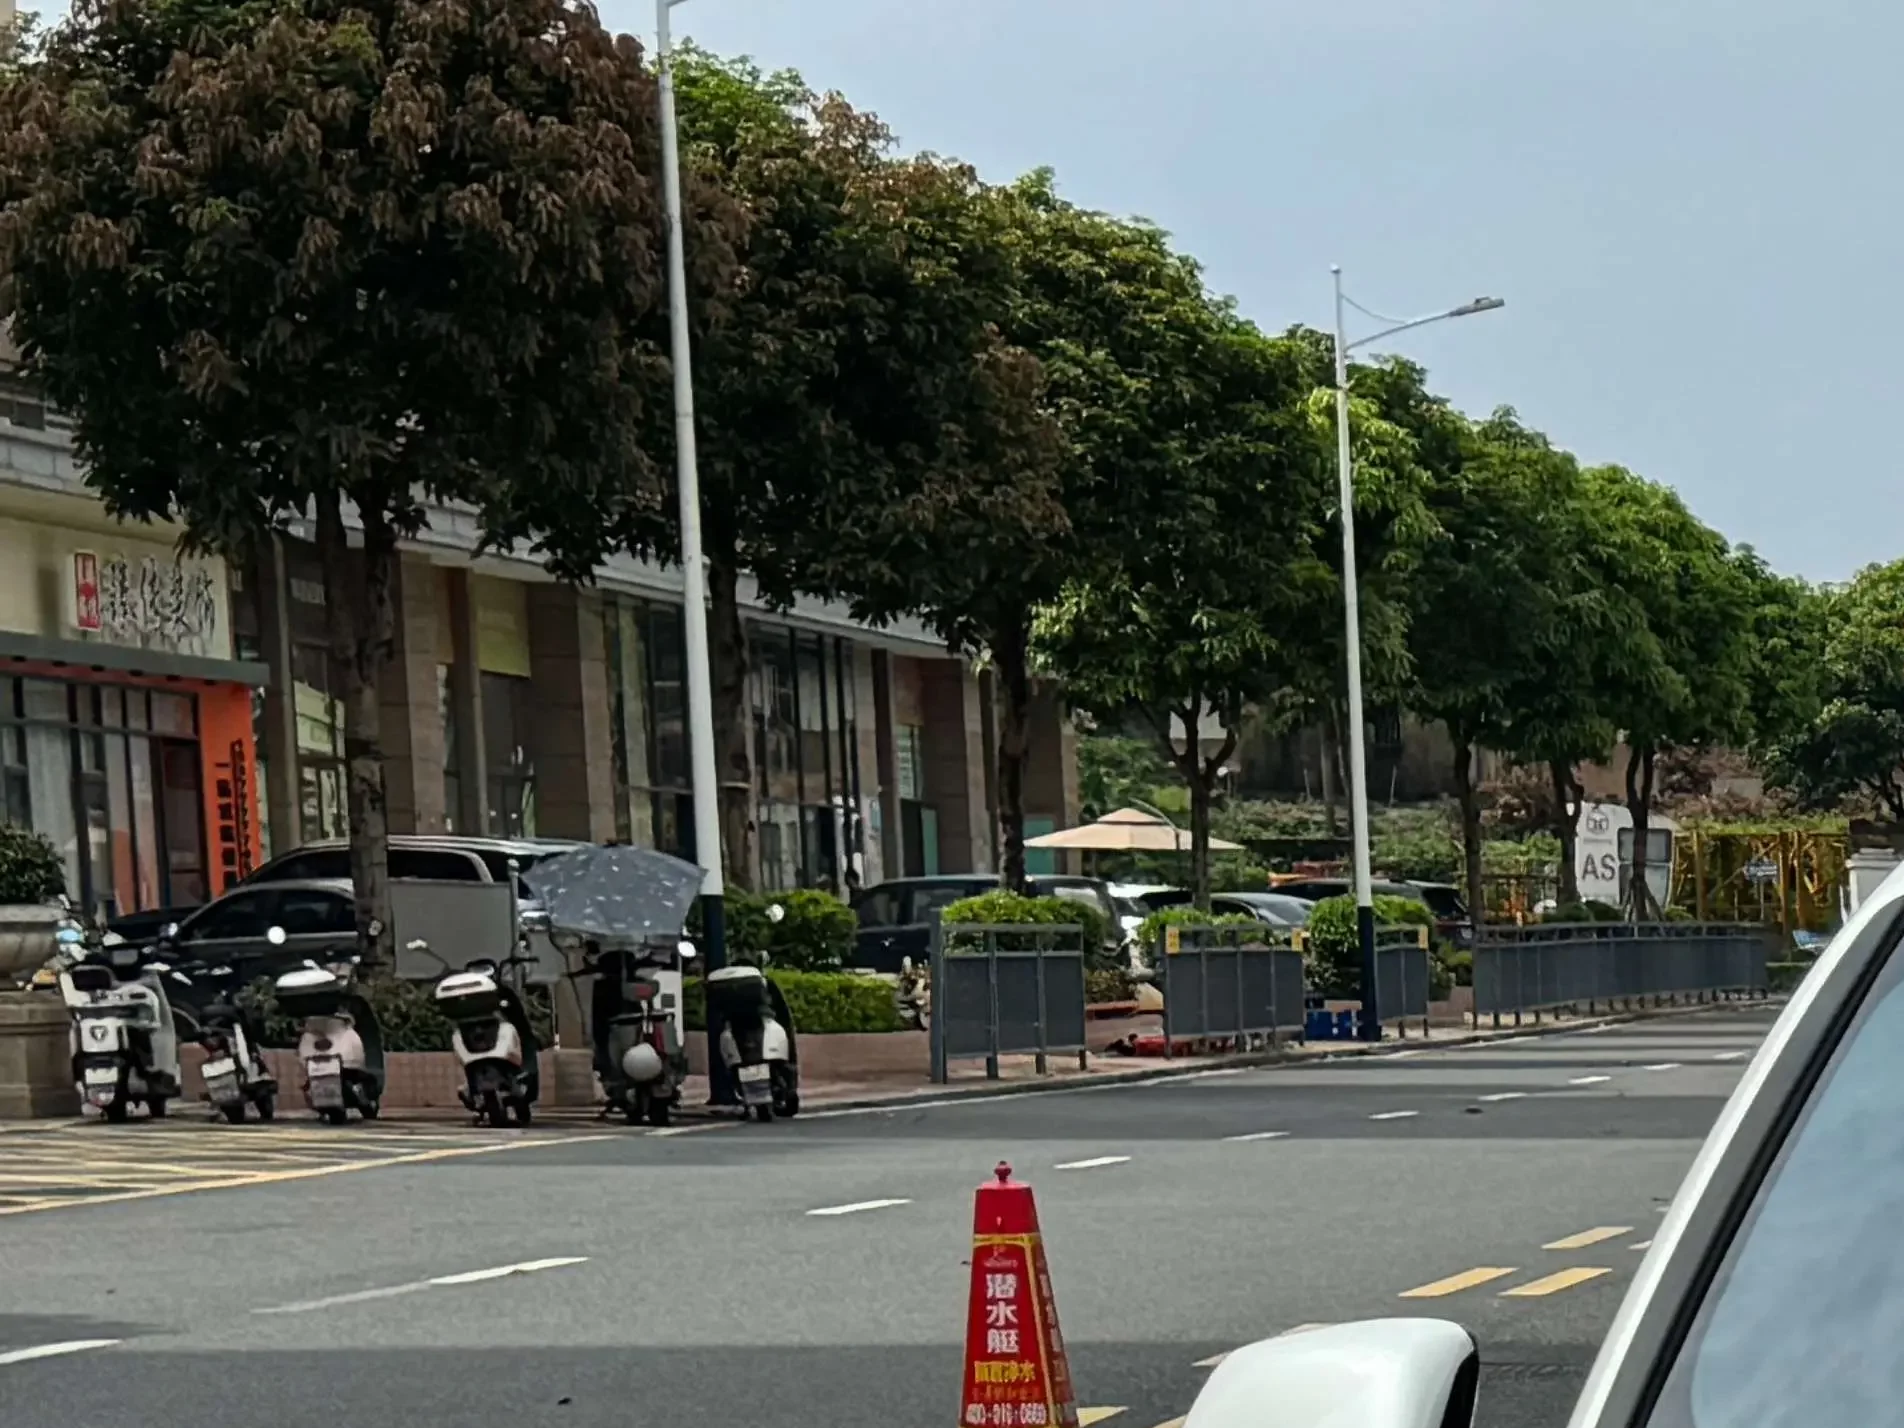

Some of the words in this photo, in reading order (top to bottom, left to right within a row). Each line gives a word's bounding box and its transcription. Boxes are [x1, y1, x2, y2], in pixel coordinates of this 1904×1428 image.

[1582, 853, 1616, 882] AS
[985, 1273, 1020, 1354] 潜水艇
